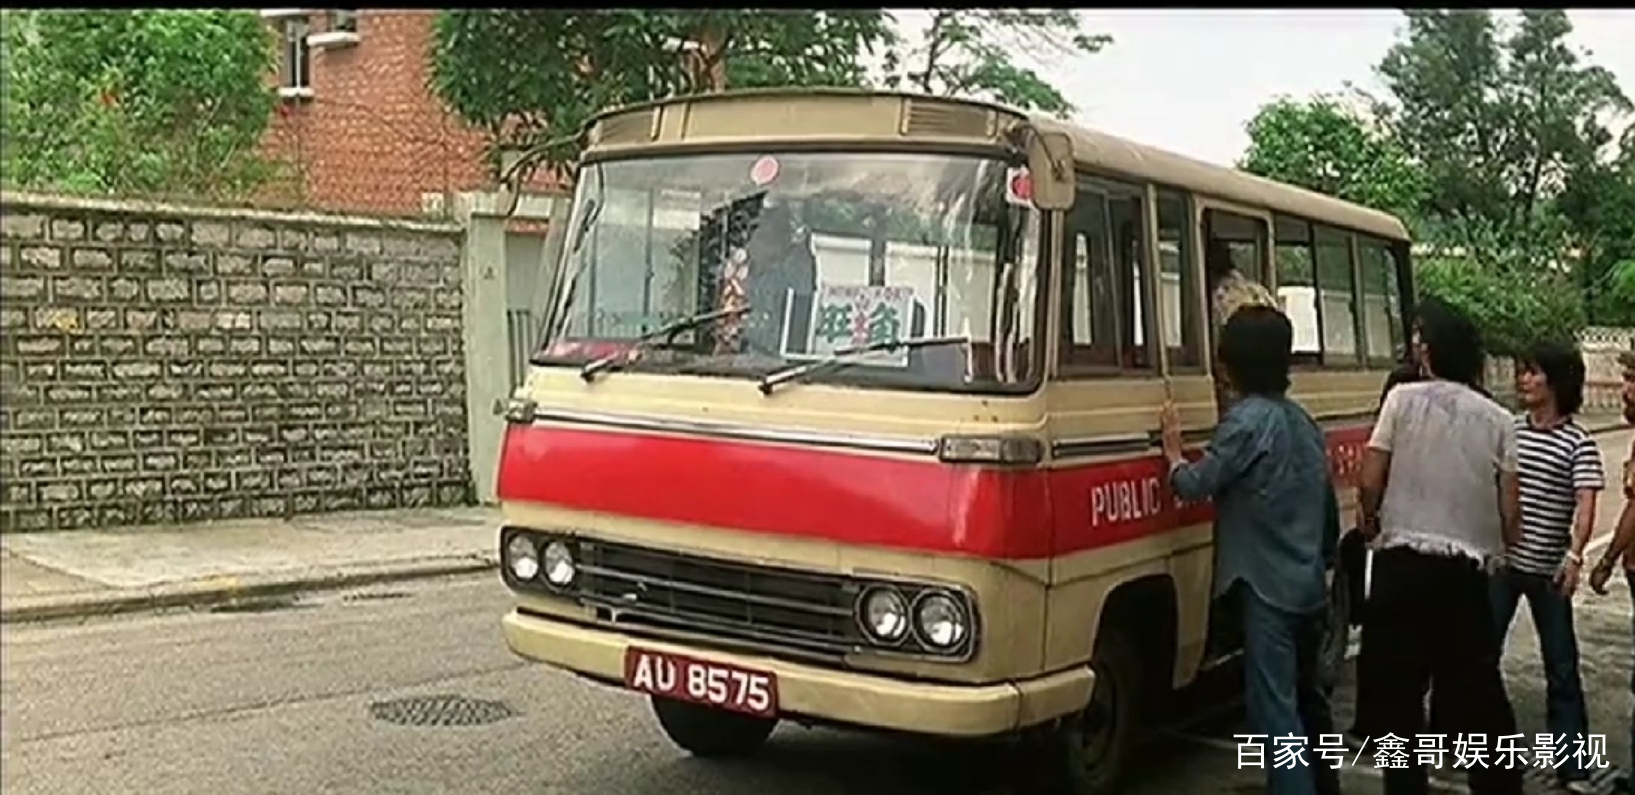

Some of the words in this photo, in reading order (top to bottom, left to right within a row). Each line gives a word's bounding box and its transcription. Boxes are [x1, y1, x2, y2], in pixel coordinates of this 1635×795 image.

[1091, 477, 1161, 527] PUBLIC
[633, 654, 676, 691] AU
[687, 663, 770, 710] 8575
